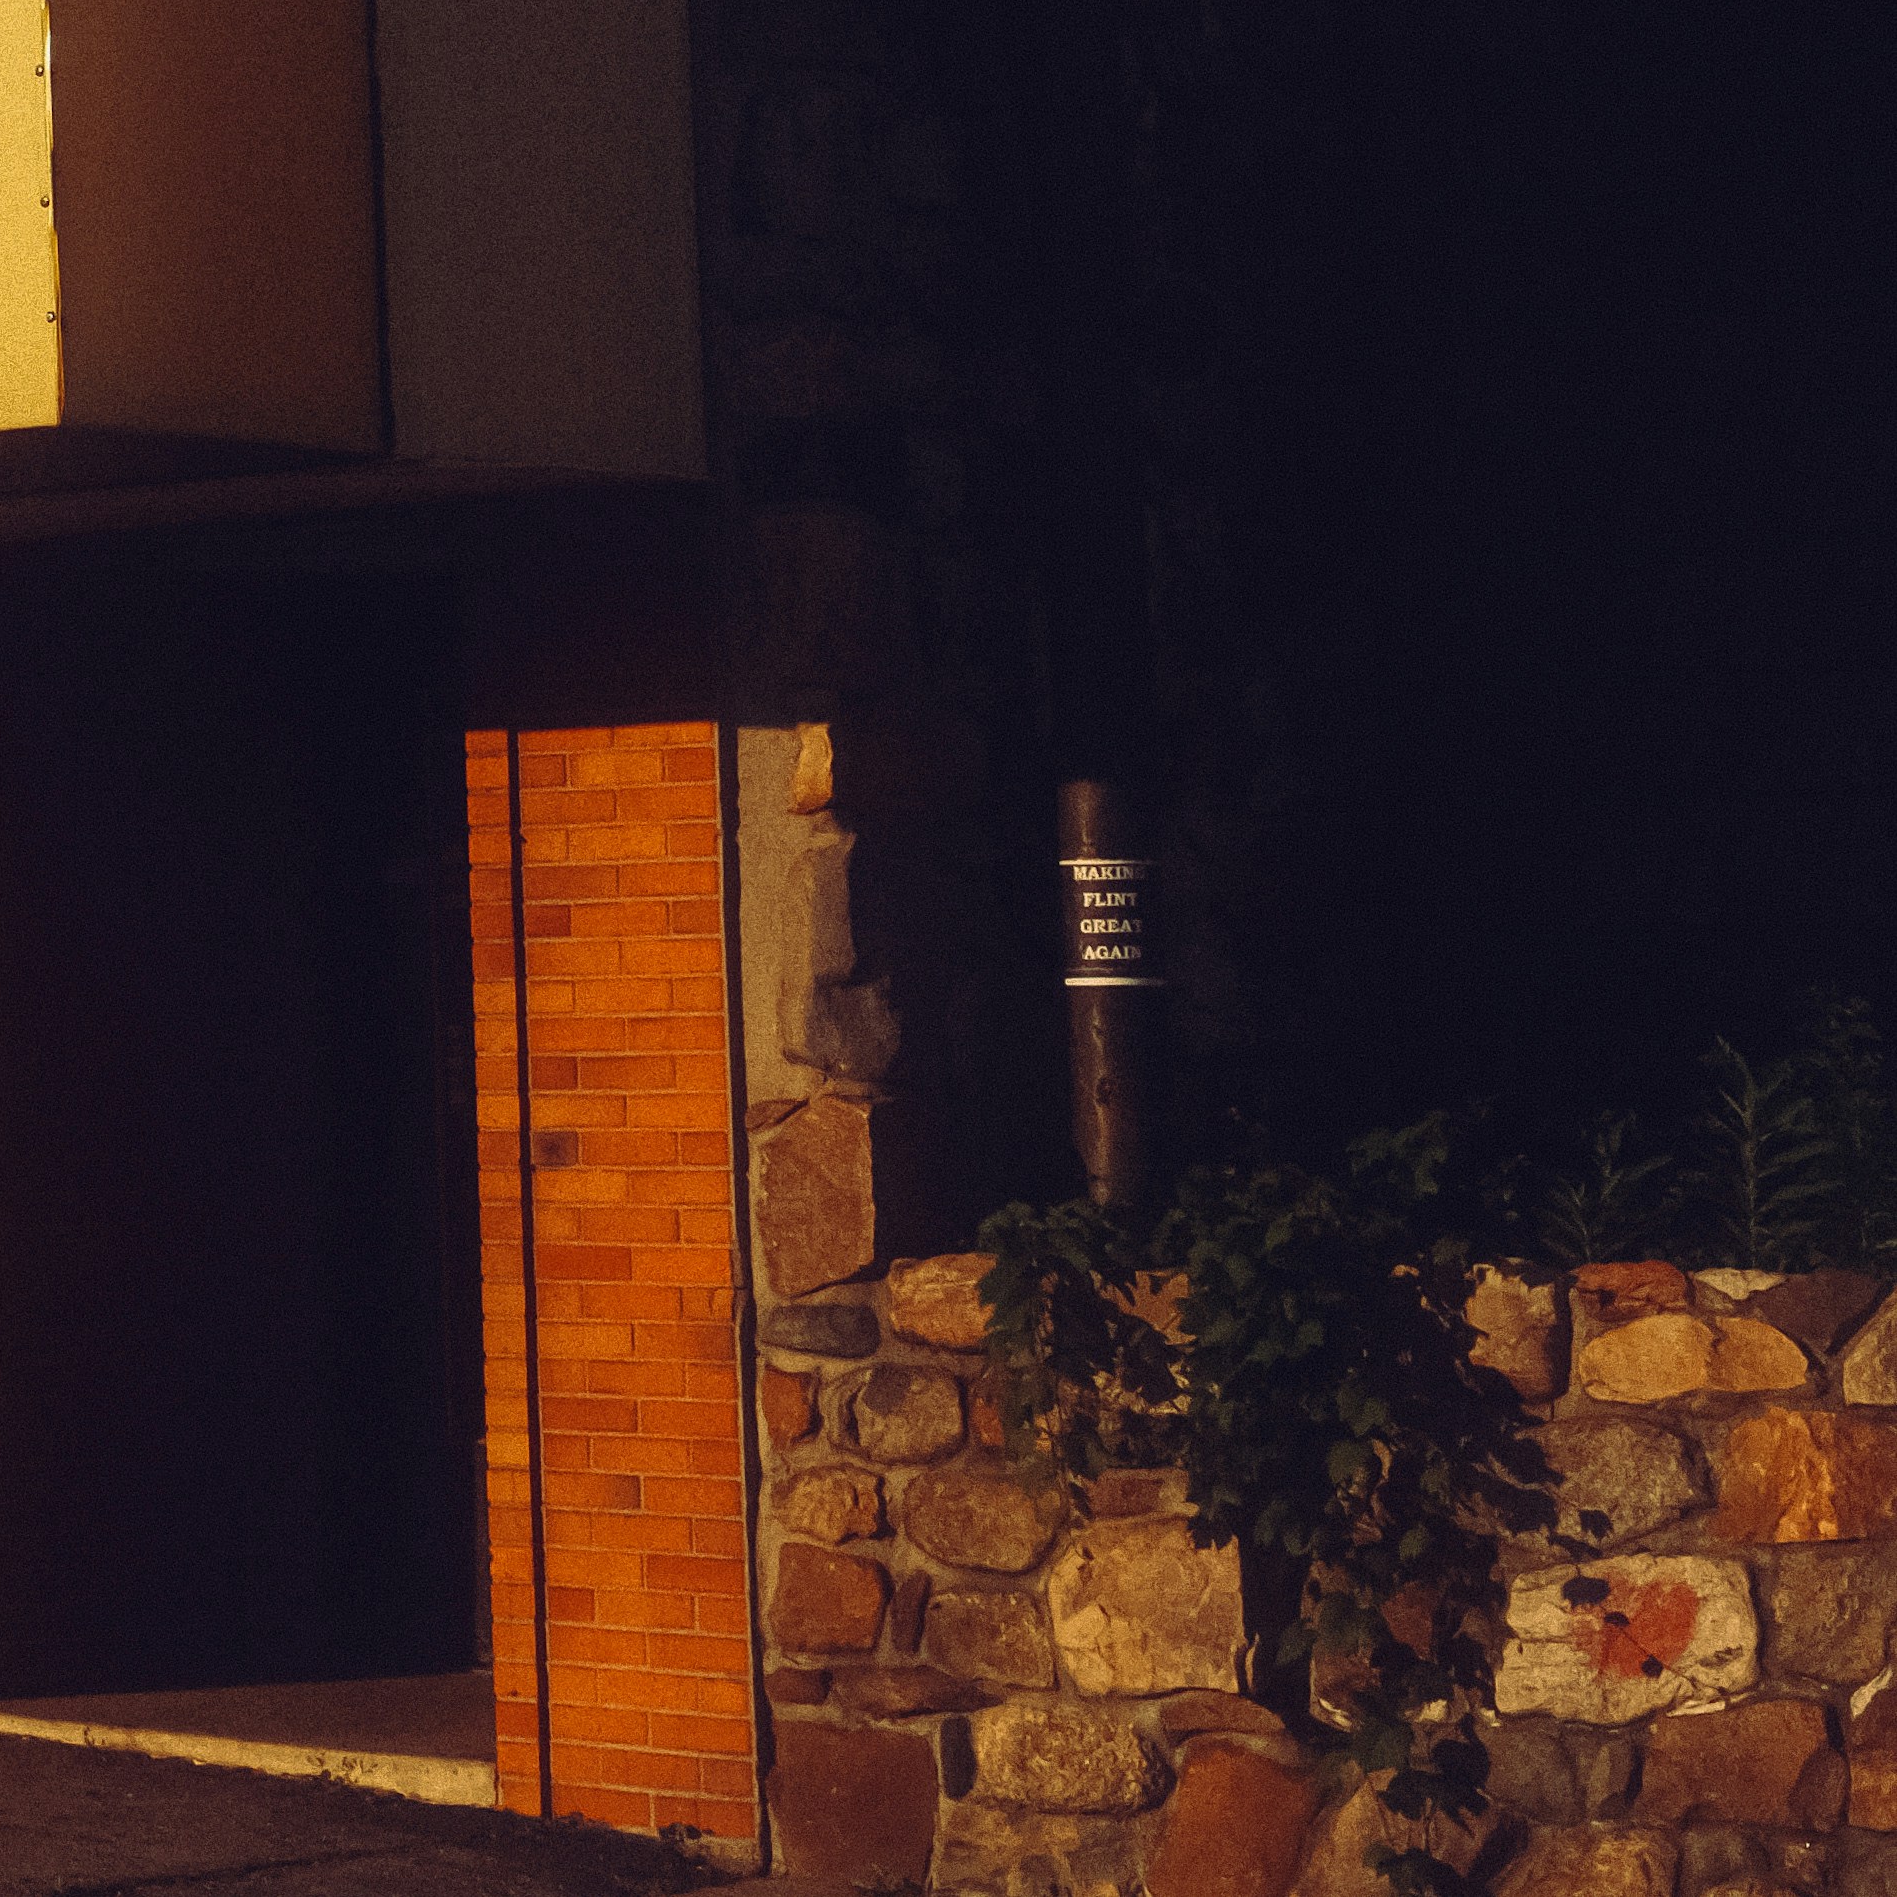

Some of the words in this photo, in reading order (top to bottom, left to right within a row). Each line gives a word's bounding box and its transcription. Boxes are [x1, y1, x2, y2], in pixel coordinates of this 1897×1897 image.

[1082, 891, 1138, 907] FLINT
[1079, 918, 1143, 934] GREAT
[1081, 945, 1142, 960] AGAIN
